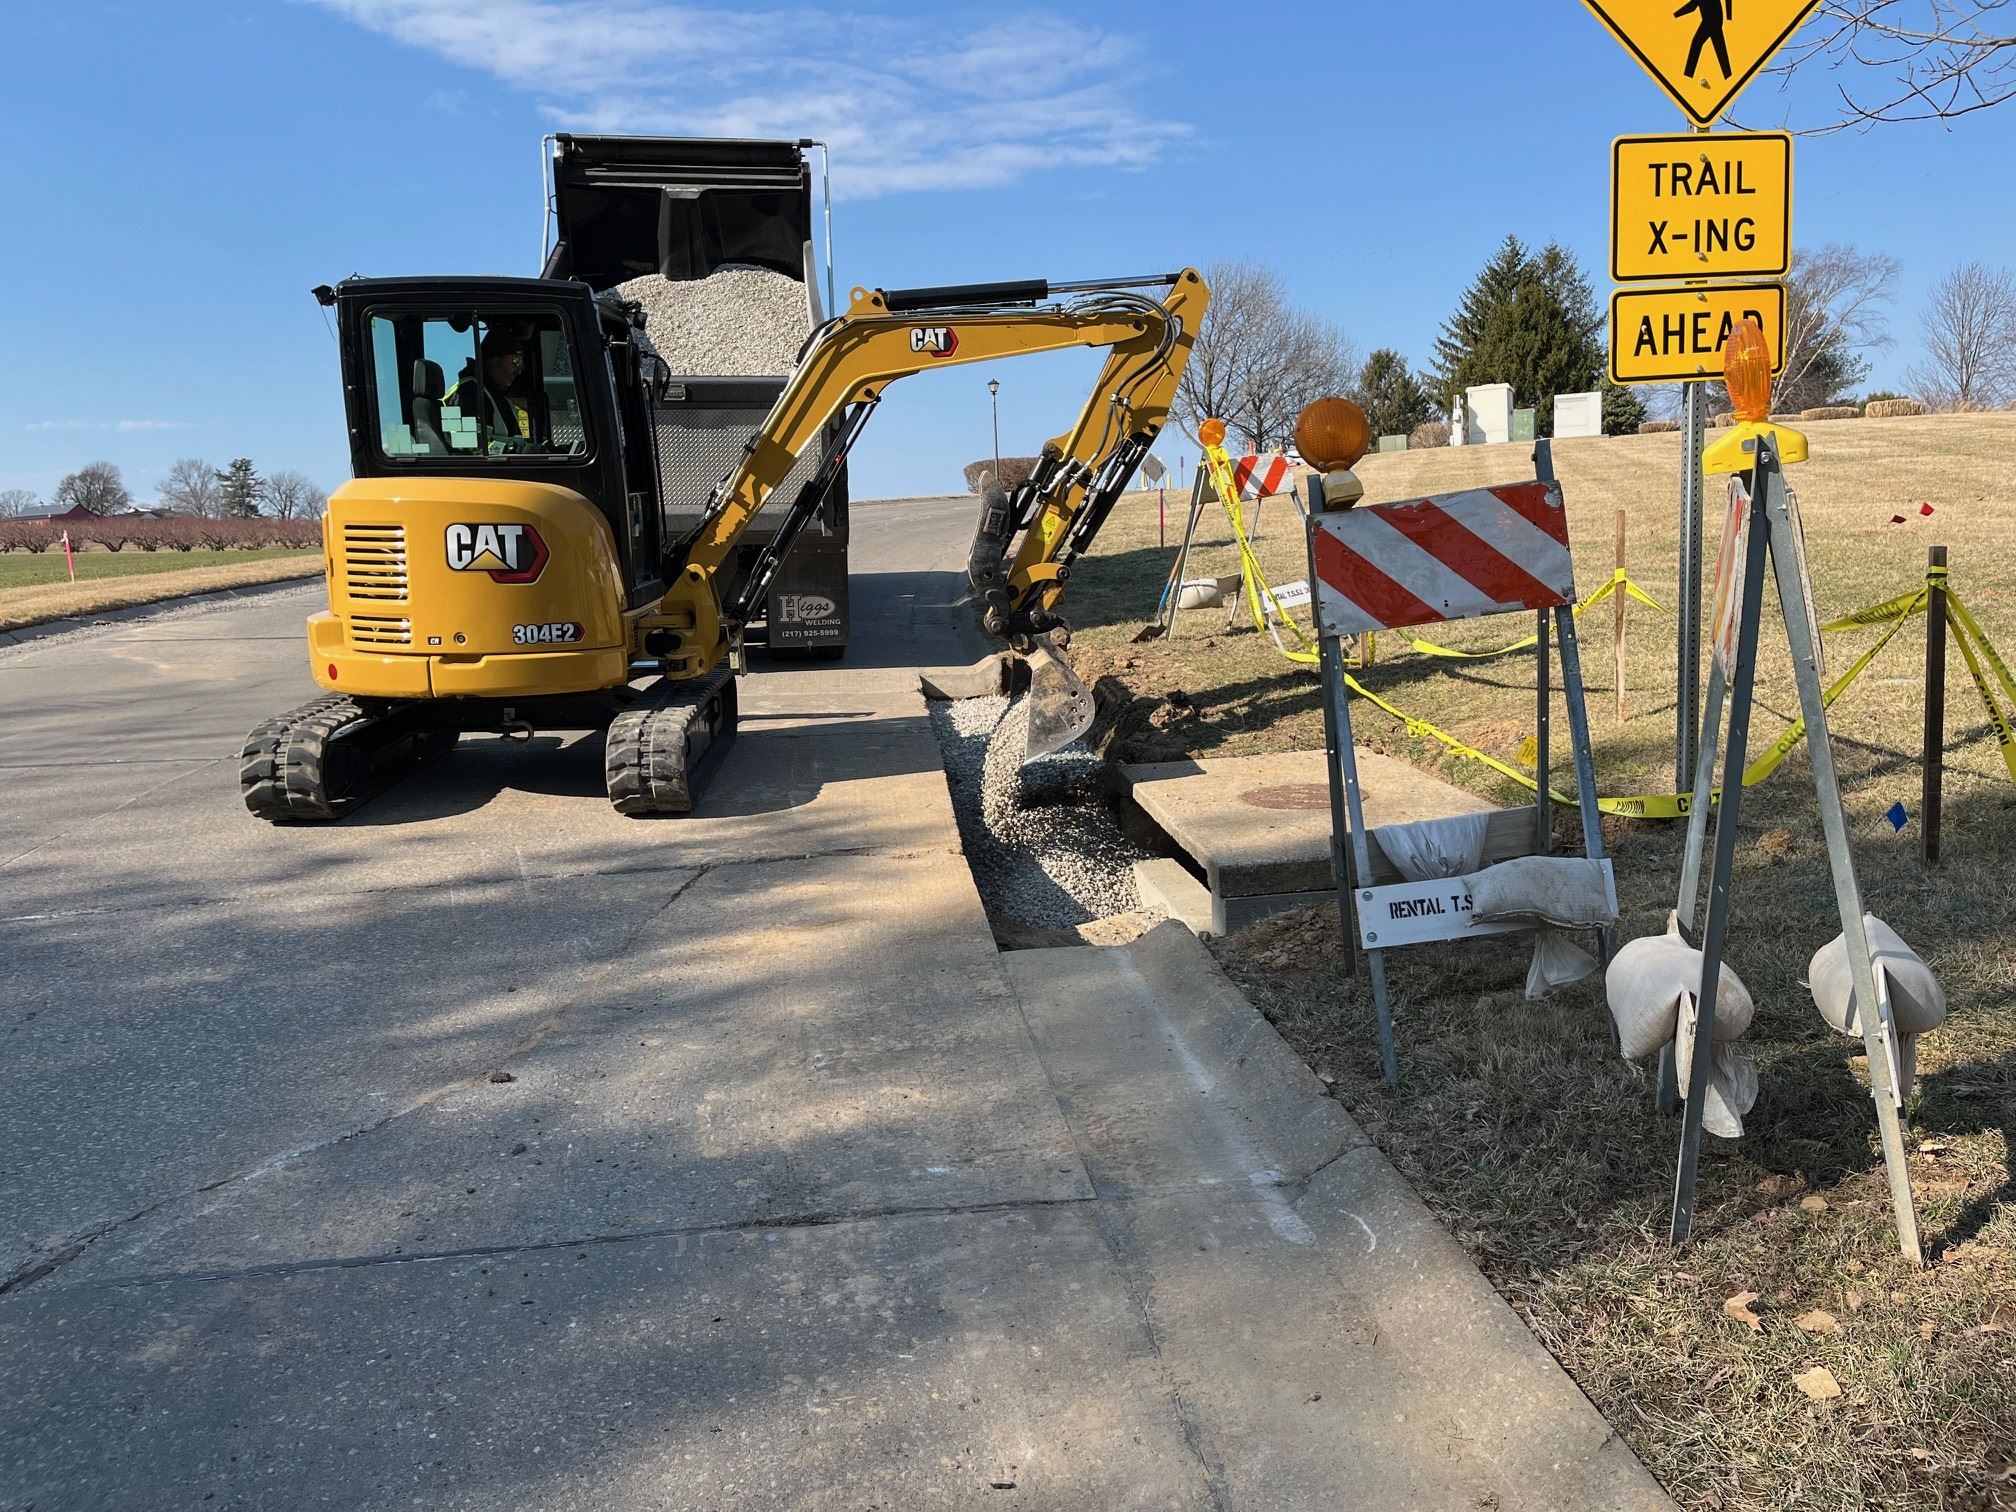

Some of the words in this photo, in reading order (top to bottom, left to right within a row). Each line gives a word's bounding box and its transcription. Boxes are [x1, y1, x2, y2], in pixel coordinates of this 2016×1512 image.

[1648, 161, 1756, 197] TRAIL
[1647, 217, 1756, 255] X-ING
[910, 328, 947, 351] CAT
[446, 524, 523, 570] CAT
[778, 594, 831, 623] Higgs
[513, 623, 575, 644] 304E2
[805, 618, 841, 626] WELDING
[781, 630, 802, 639] (217)
[1615, 799, 1645, 815] CAUTION
[1389, 897, 1446, 920] RENTAL
